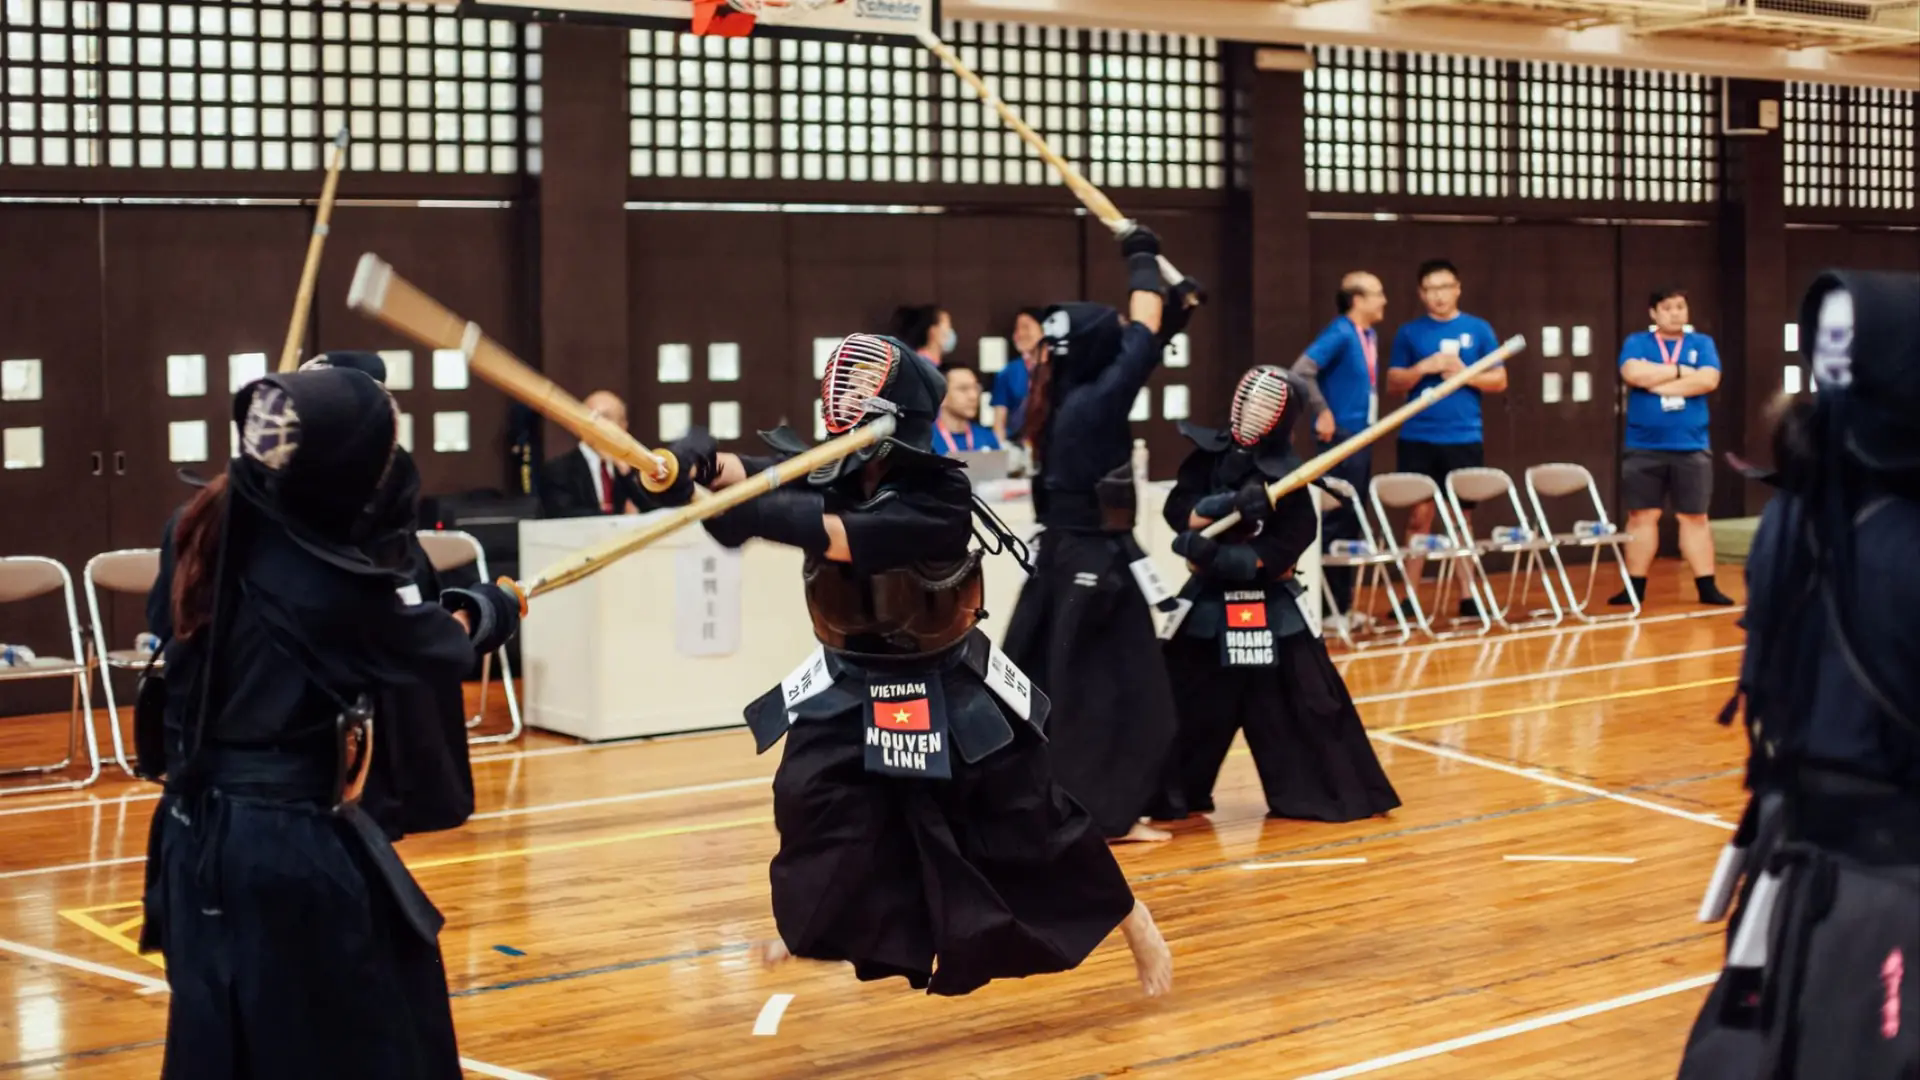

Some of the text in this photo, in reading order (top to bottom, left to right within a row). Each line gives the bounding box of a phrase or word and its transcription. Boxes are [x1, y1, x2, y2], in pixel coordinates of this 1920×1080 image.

[1226, 630, 1272, 647] HOANG
[1227, 647, 1274, 665] TRANG
[801, 668, 812, 694] VIE
[1004, 664, 1015, 688] VIE
[789, 685, 800, 701] 21
[870, 682, 926, 698] VIETNAM
[1016, 681, 1027, 698] 21
[883, 747, 926, 770] LINH
